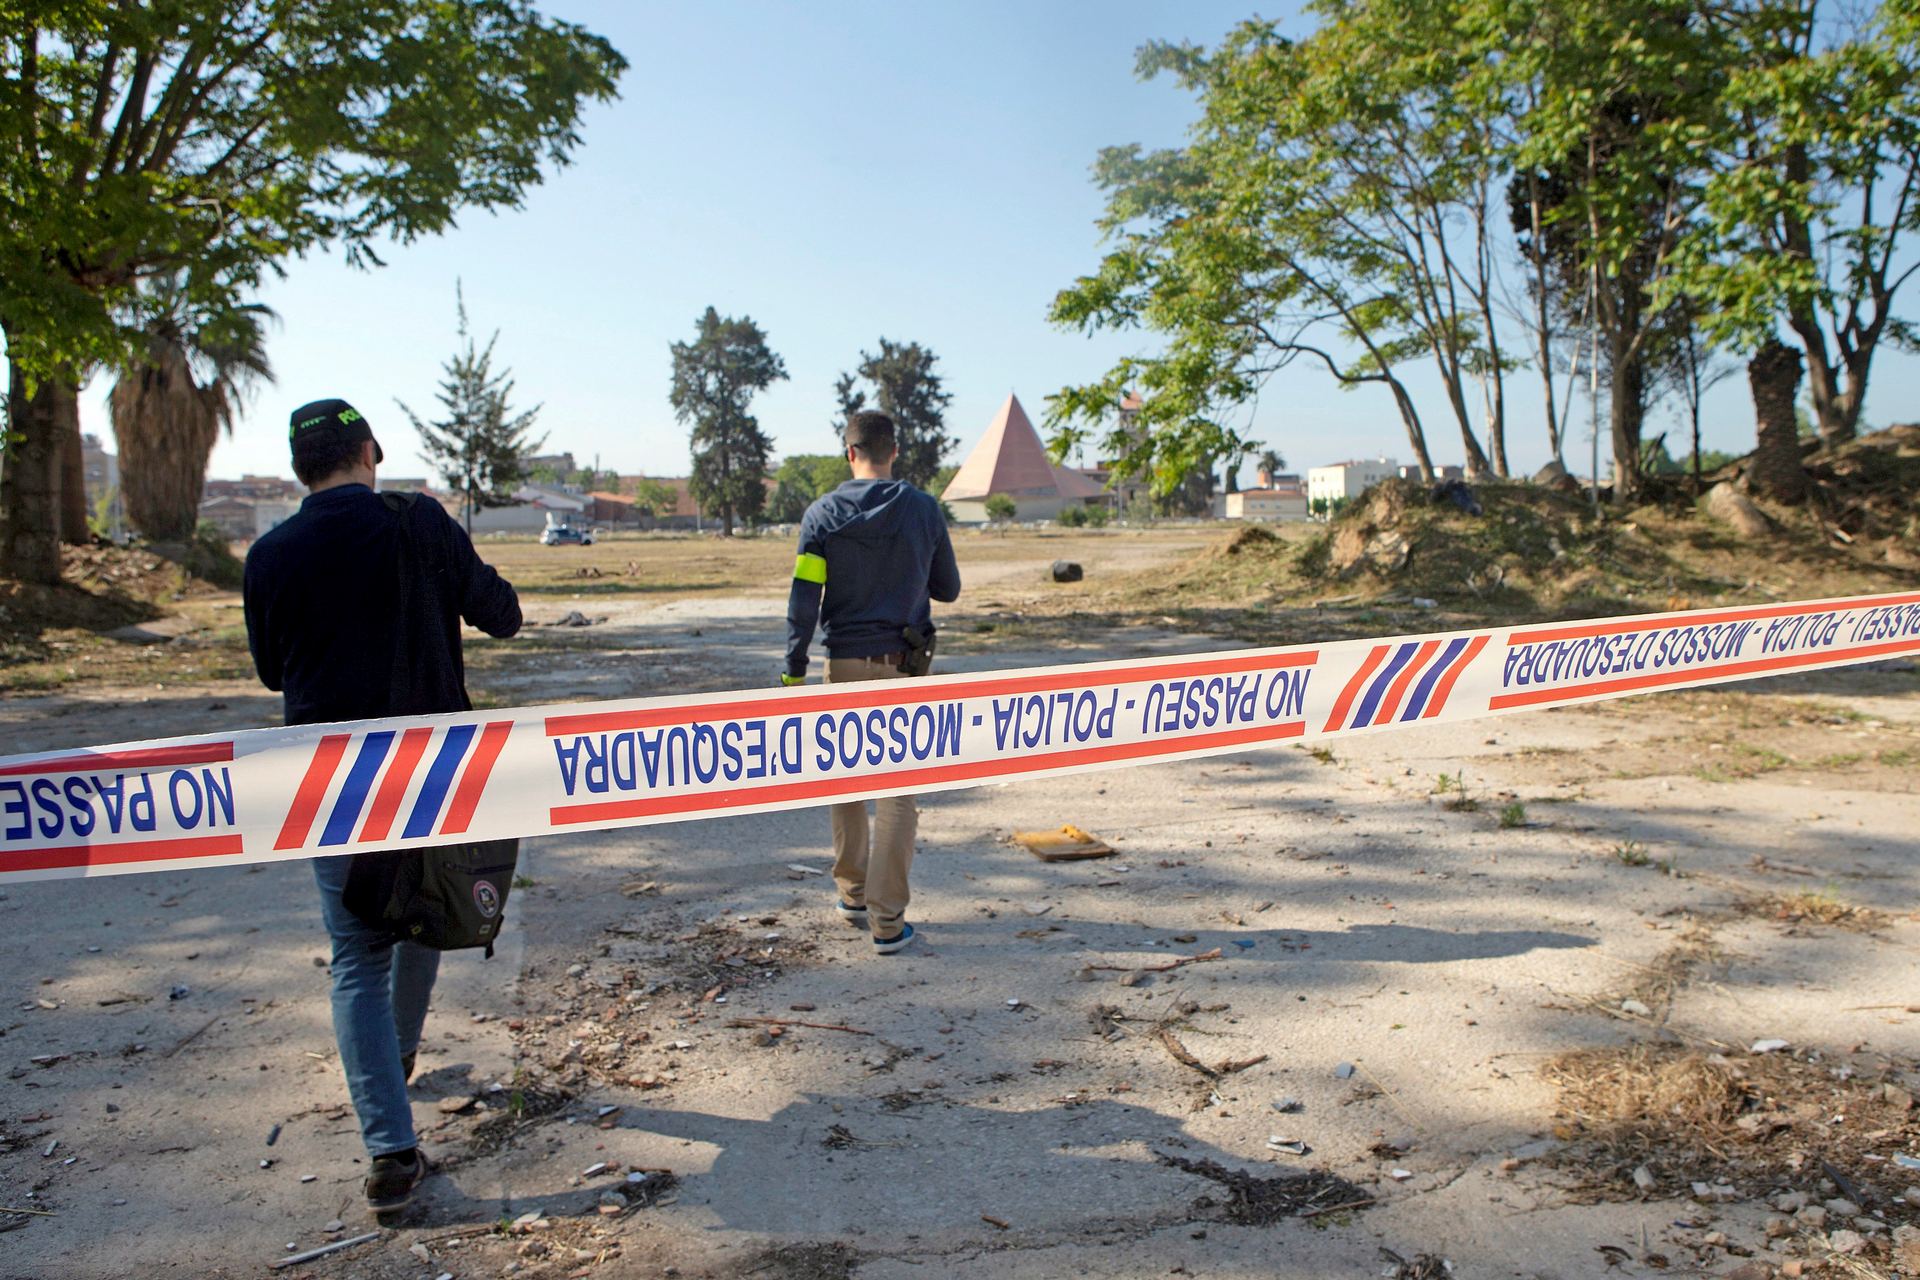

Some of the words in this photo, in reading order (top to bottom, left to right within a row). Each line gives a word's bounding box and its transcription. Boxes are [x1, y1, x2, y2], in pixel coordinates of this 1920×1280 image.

[1503, 631, 1660, 687] D'ESQUADRA
[1654, 621, 1757, 668] MOSSOS
[1761, 611, 1852, 653] POLICIA
[993, 687, 1119, 751] POLICIA
[1142, 673, 1262, 733] PASSEU
[1267, 669, 1311, 719] NO
[553, 716, 802, 796] D'ESQUADRA
[815, 702, 963, 772] MOSSOS
[0, 773, 157, 841] PASSE
[169, 767, 236, 830] NO
